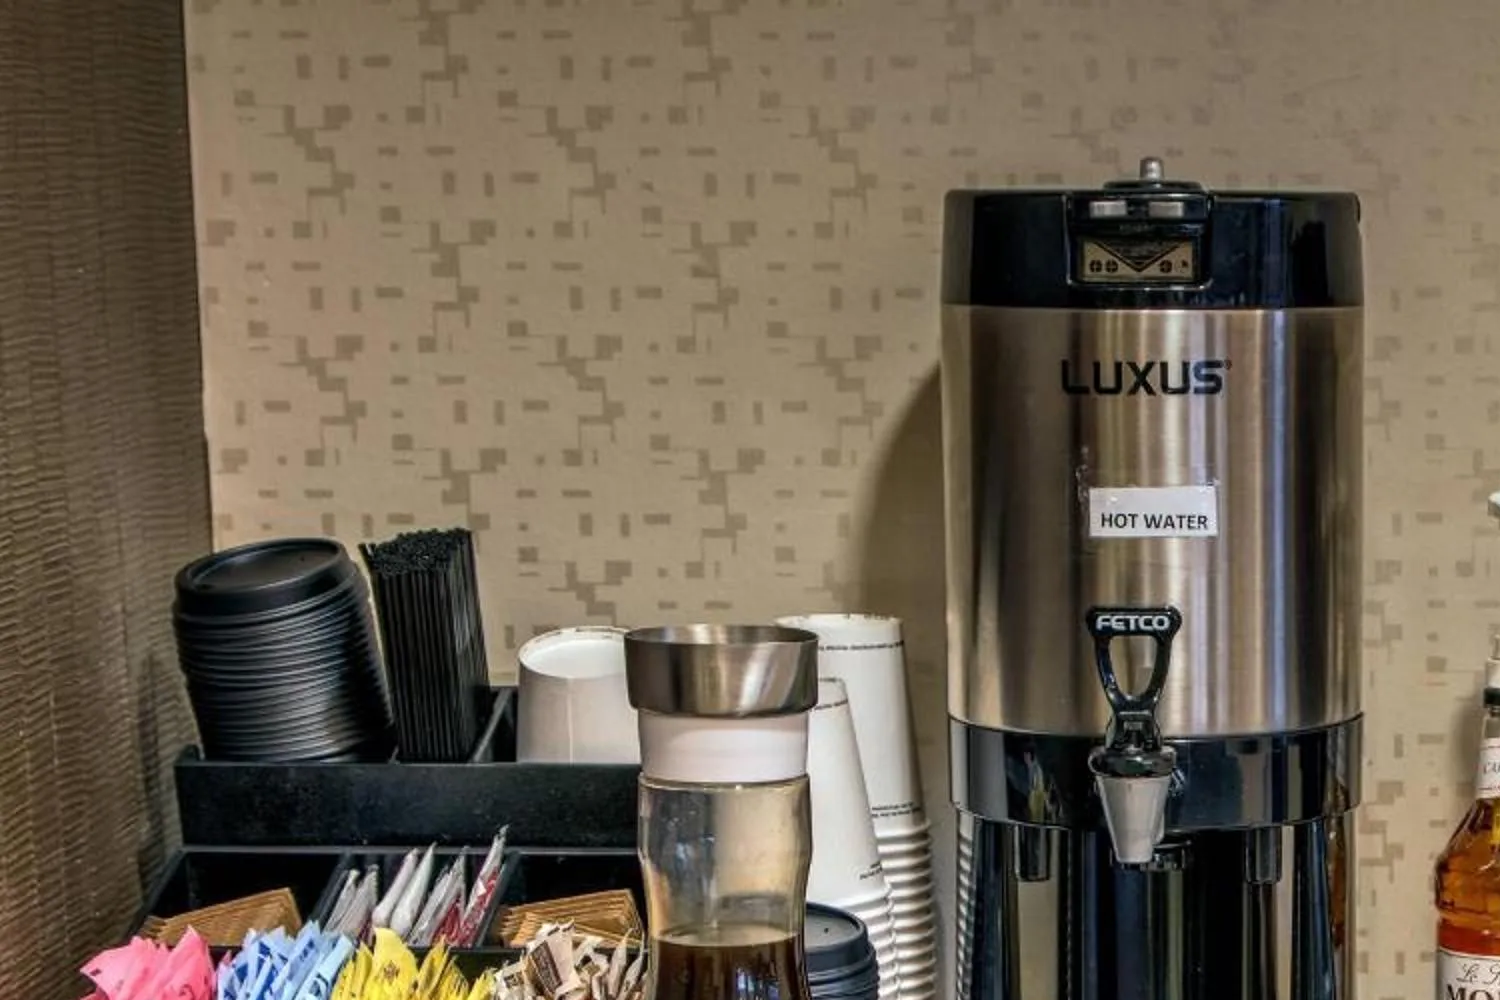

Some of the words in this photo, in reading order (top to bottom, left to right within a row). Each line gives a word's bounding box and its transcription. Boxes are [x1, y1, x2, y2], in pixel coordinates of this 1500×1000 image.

[1101, 513, 1139, 530] HOT
[1144, 514, 1209, 531] WATER
[1095, 615, 1171, 631] FETCO
